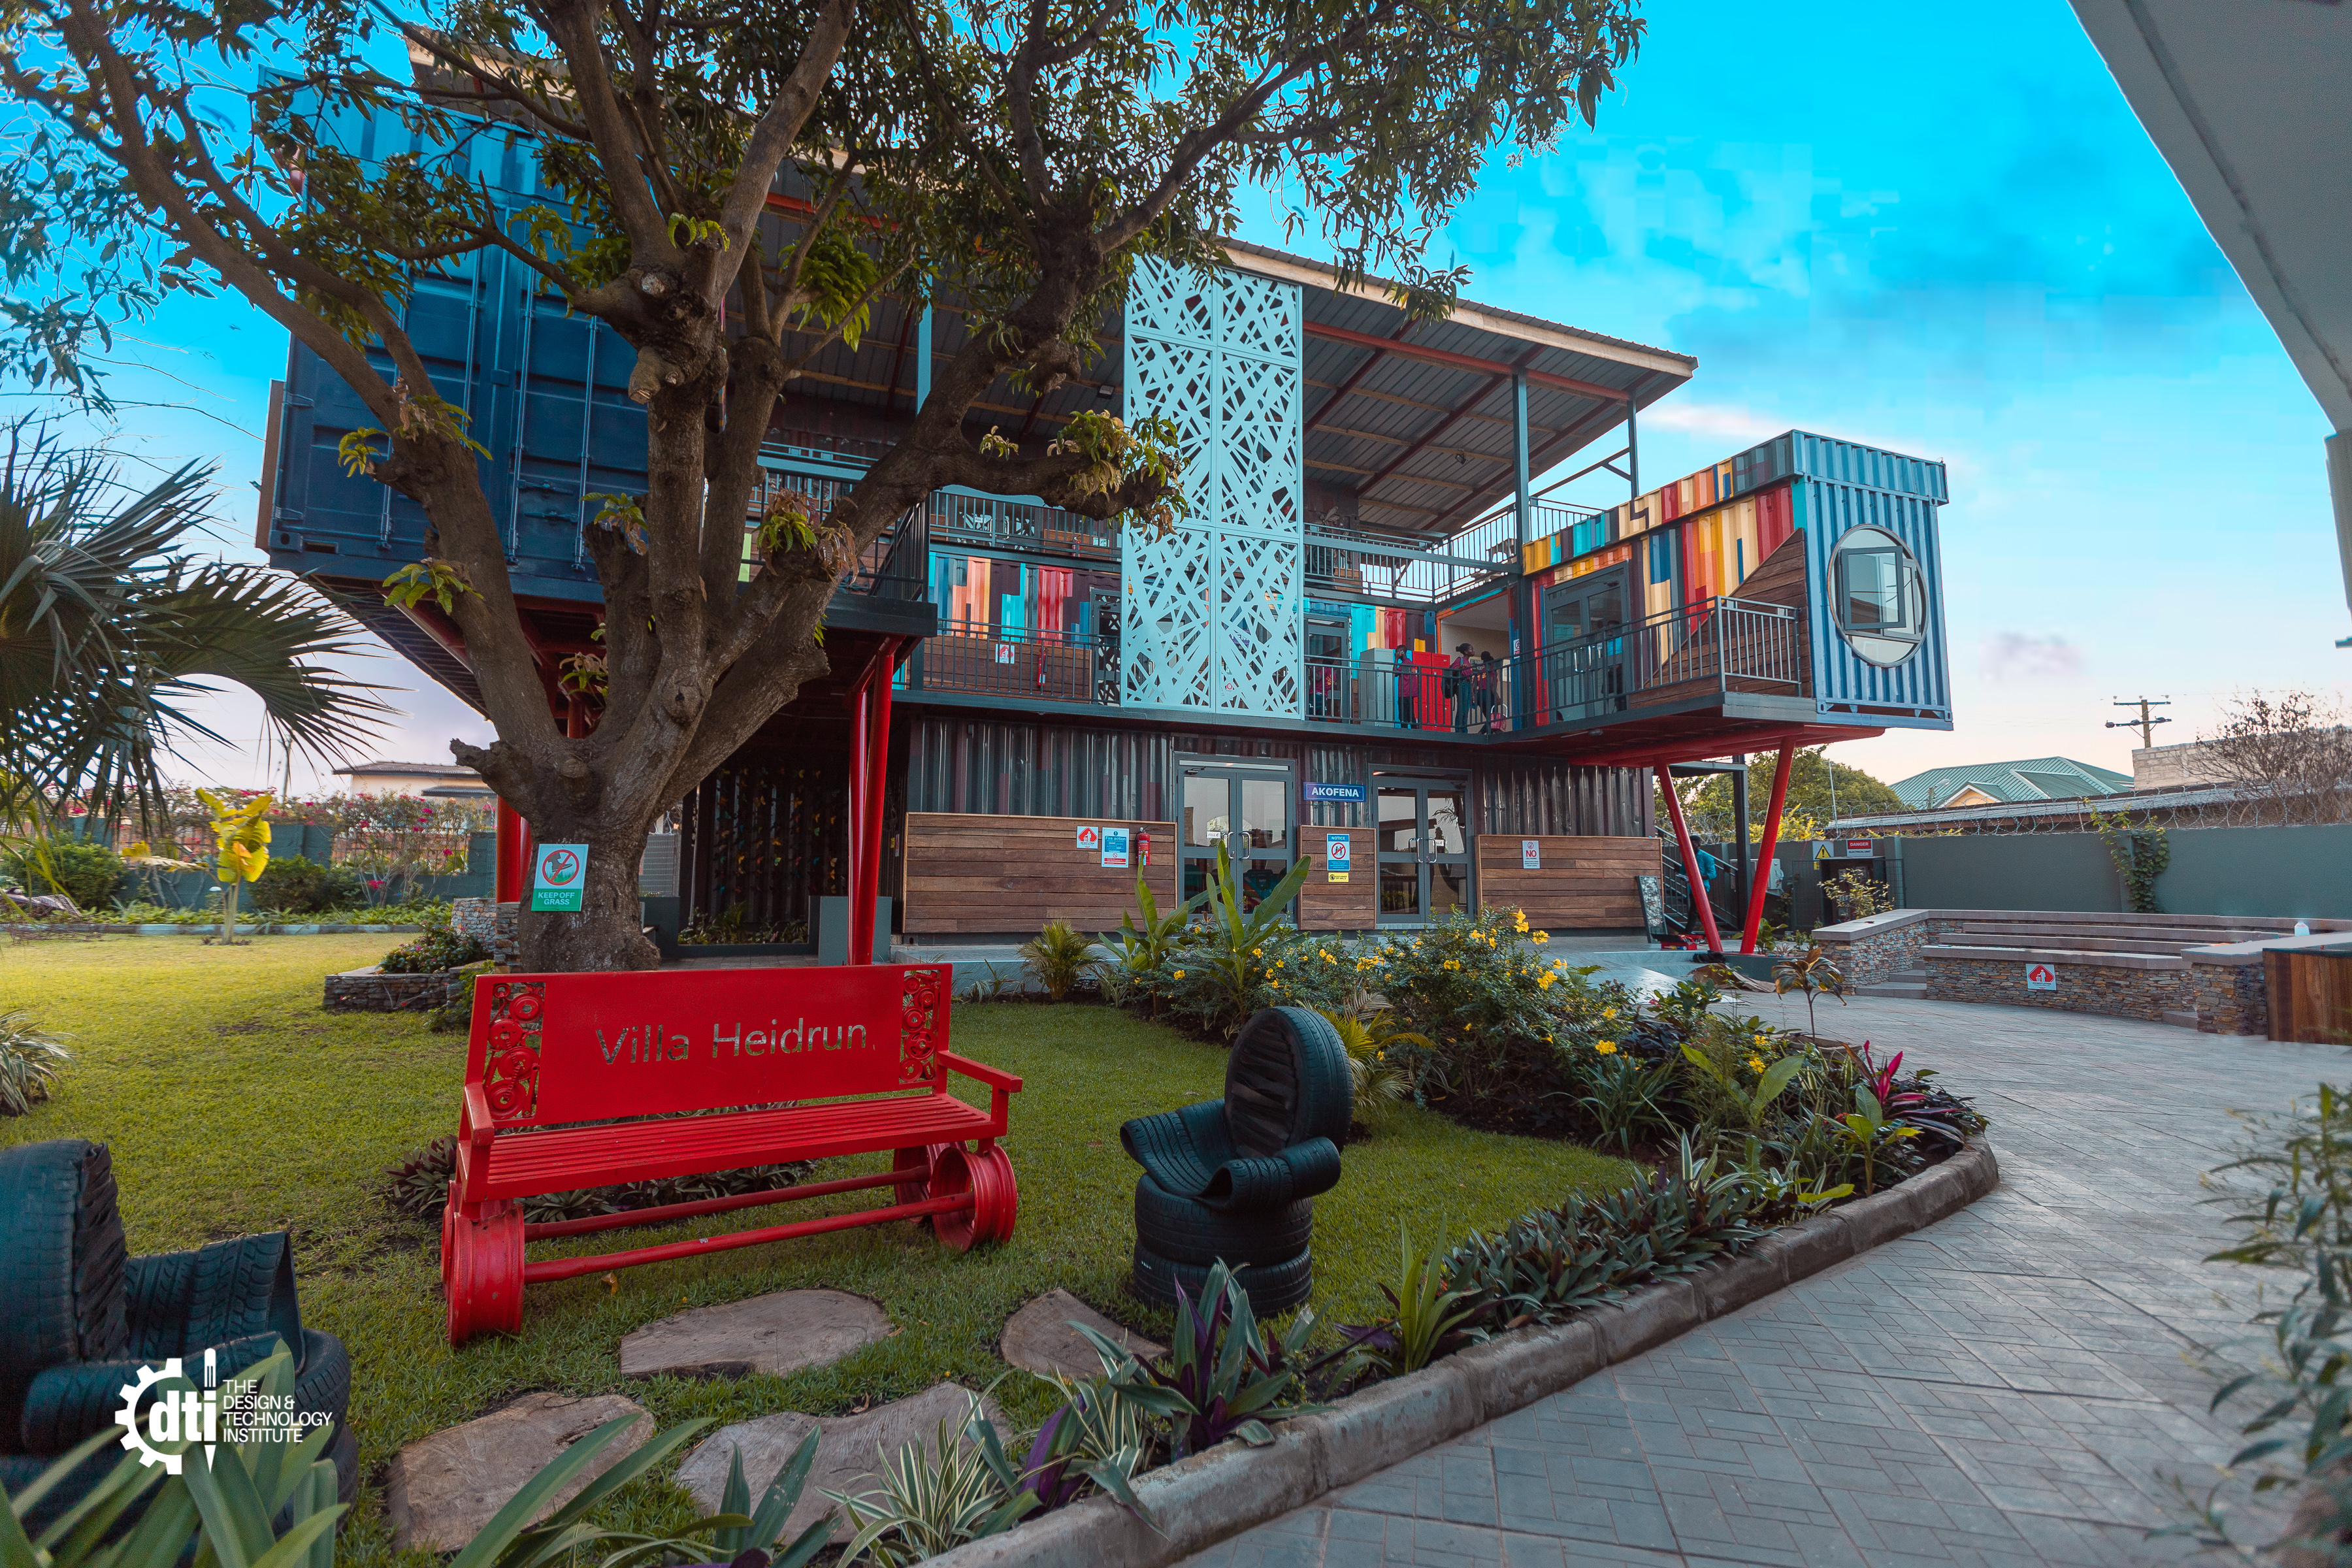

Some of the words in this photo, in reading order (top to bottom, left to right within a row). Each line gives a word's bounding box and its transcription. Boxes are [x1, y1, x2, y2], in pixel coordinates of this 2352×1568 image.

[1311, 787, 1359, 797] AKOFENA
[595, 1024, 690, 1065] Villa
[712, 1017, 867, 1058] Heidrun
